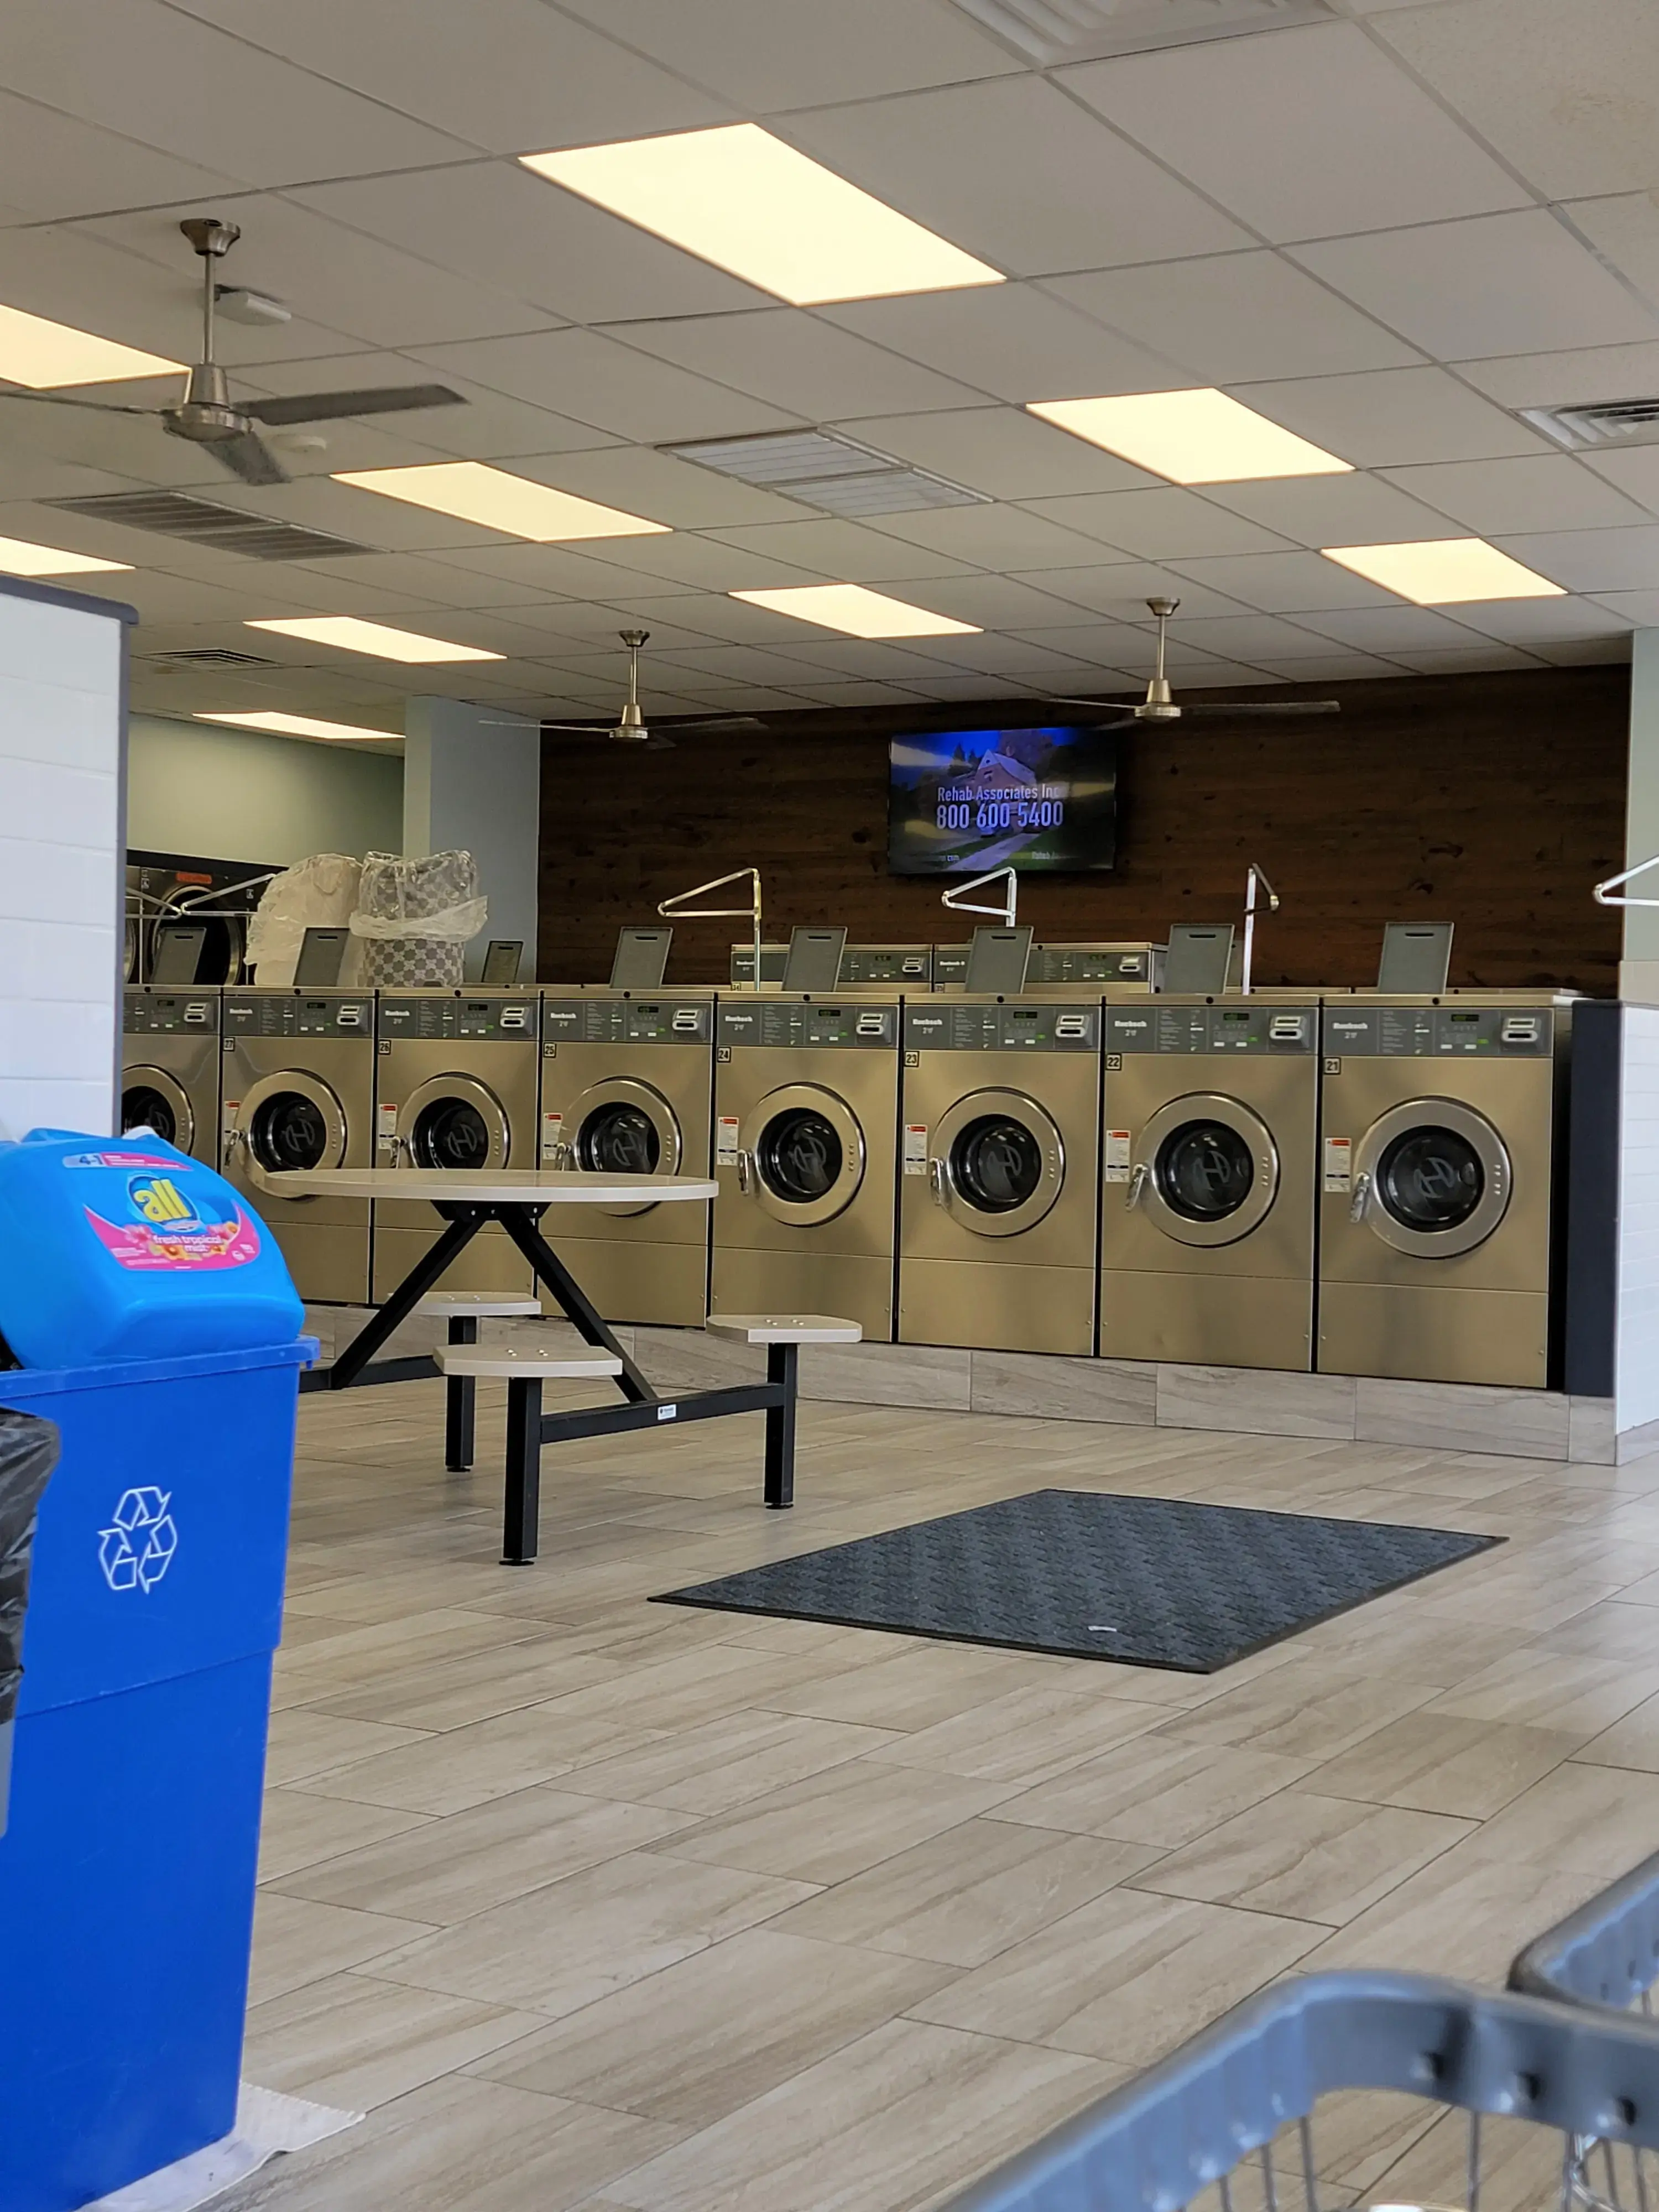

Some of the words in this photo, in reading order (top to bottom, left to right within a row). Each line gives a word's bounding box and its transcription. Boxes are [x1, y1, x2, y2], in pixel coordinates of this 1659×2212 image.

[938, 786, 973, 801] Rehab
[975, 785, 1038, 800] Associates
[936, 804, 969, 828] 800
[976, 802, 1010, 827] 600
[1017, 801, 1063, 827] 5400
[545, 1045, 555, 1055] 25
[718, 1050, 729, 1060] 24
[906, 1053, 917, 1064] 23
[1107, 1057, 1120, 1067] 22
[1326, 1061, 1339, 1072] 21
[133, 1178, 192, 1223] all
